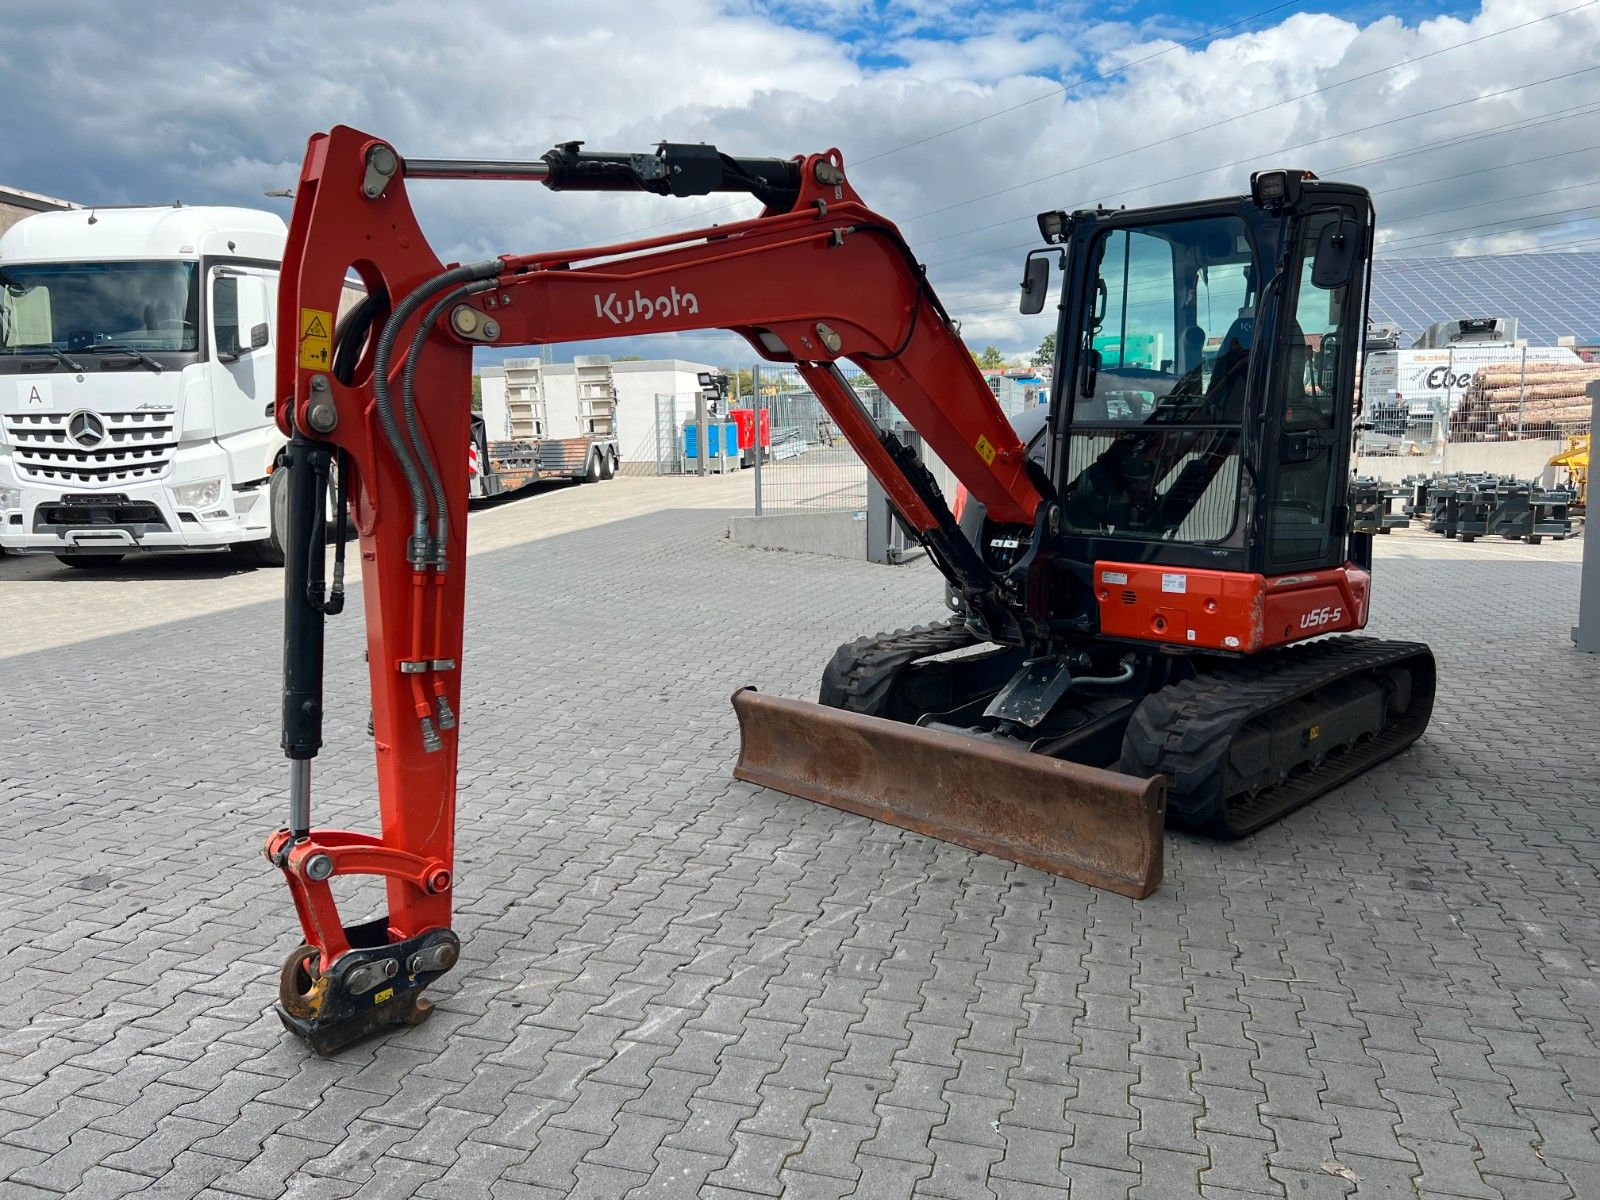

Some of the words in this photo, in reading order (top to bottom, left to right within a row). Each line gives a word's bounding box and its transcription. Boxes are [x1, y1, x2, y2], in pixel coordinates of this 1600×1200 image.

[594, 286, 699, 325] Kubota
[1240, 321, 1252, 332] K
[1426, 365, 1472, 390] Ebe
[29, 385, 42, 404] A
